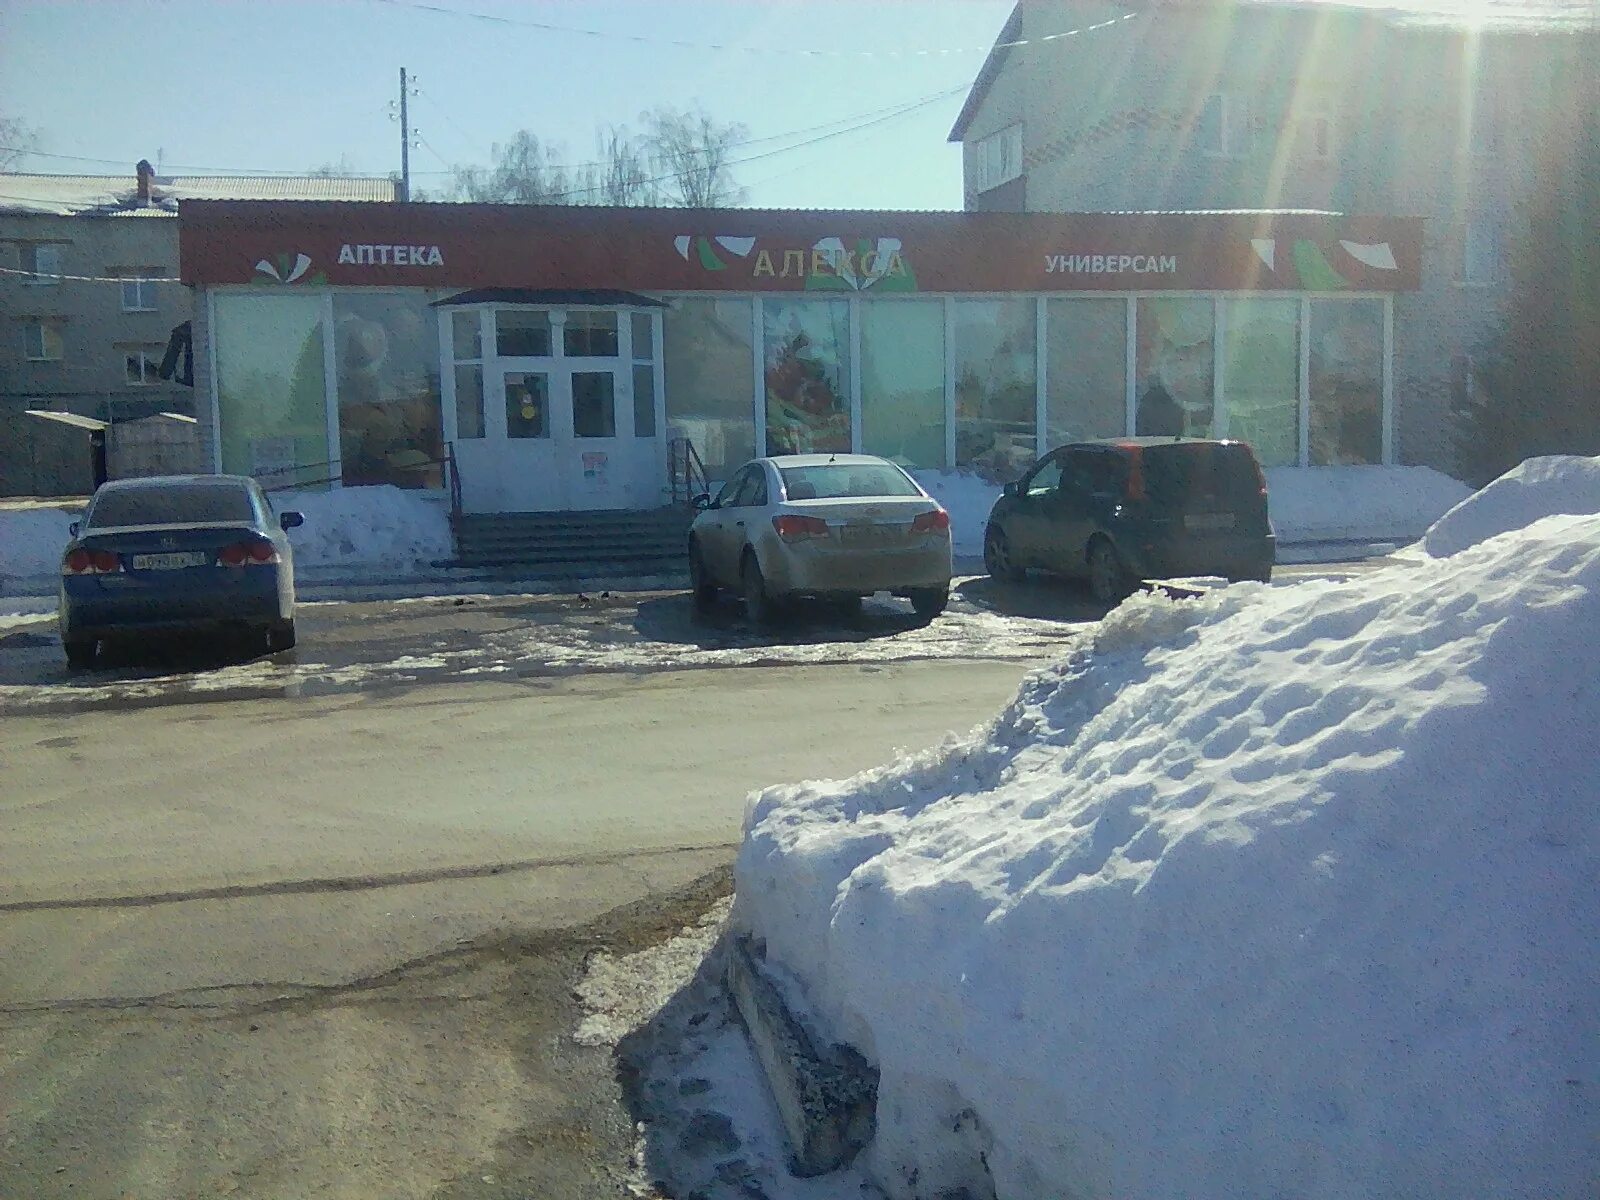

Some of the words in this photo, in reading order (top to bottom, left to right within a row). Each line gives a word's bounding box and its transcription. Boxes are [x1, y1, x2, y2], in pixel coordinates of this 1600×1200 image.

[338, 244, 444, 266] АПТЕКА
[753, 249, 907, 277] АЛЕКСА
[1044, 255, 1177, 273] УНИВЕРСАМ
